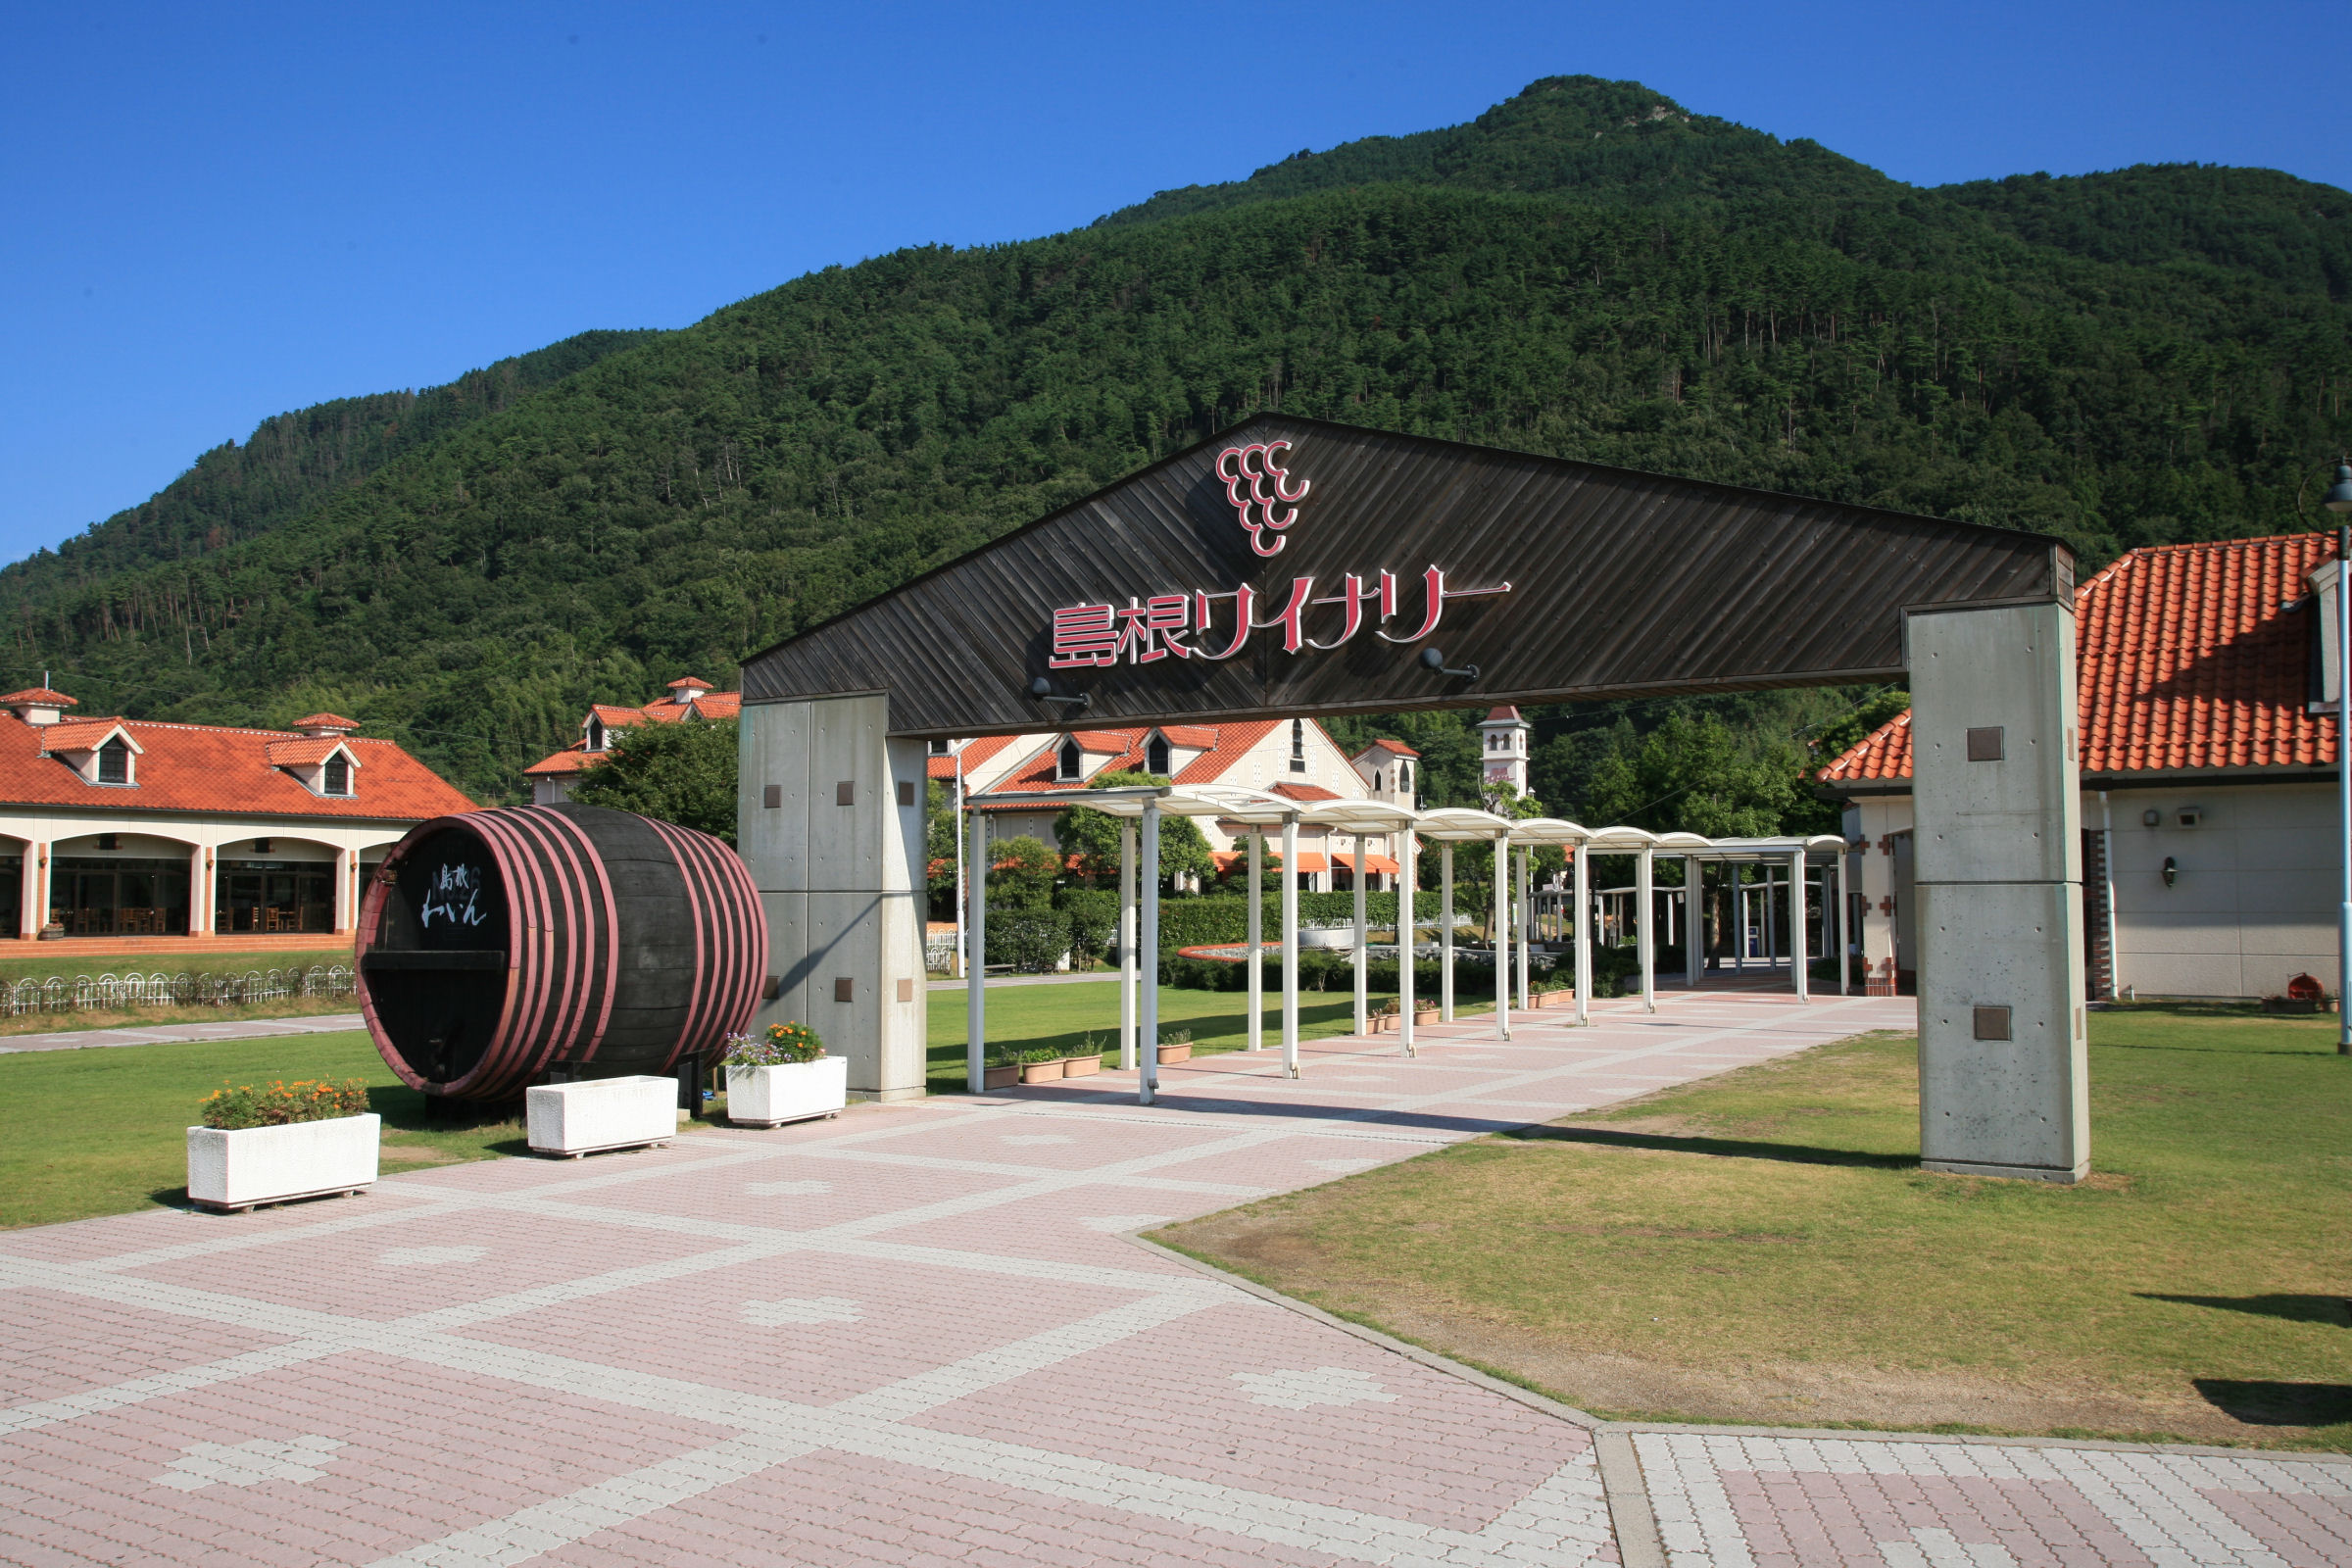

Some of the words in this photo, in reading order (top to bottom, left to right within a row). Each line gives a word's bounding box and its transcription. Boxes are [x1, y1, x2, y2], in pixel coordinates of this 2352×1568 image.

[1049, 564, 1512, 668] 島根ワイナリー
